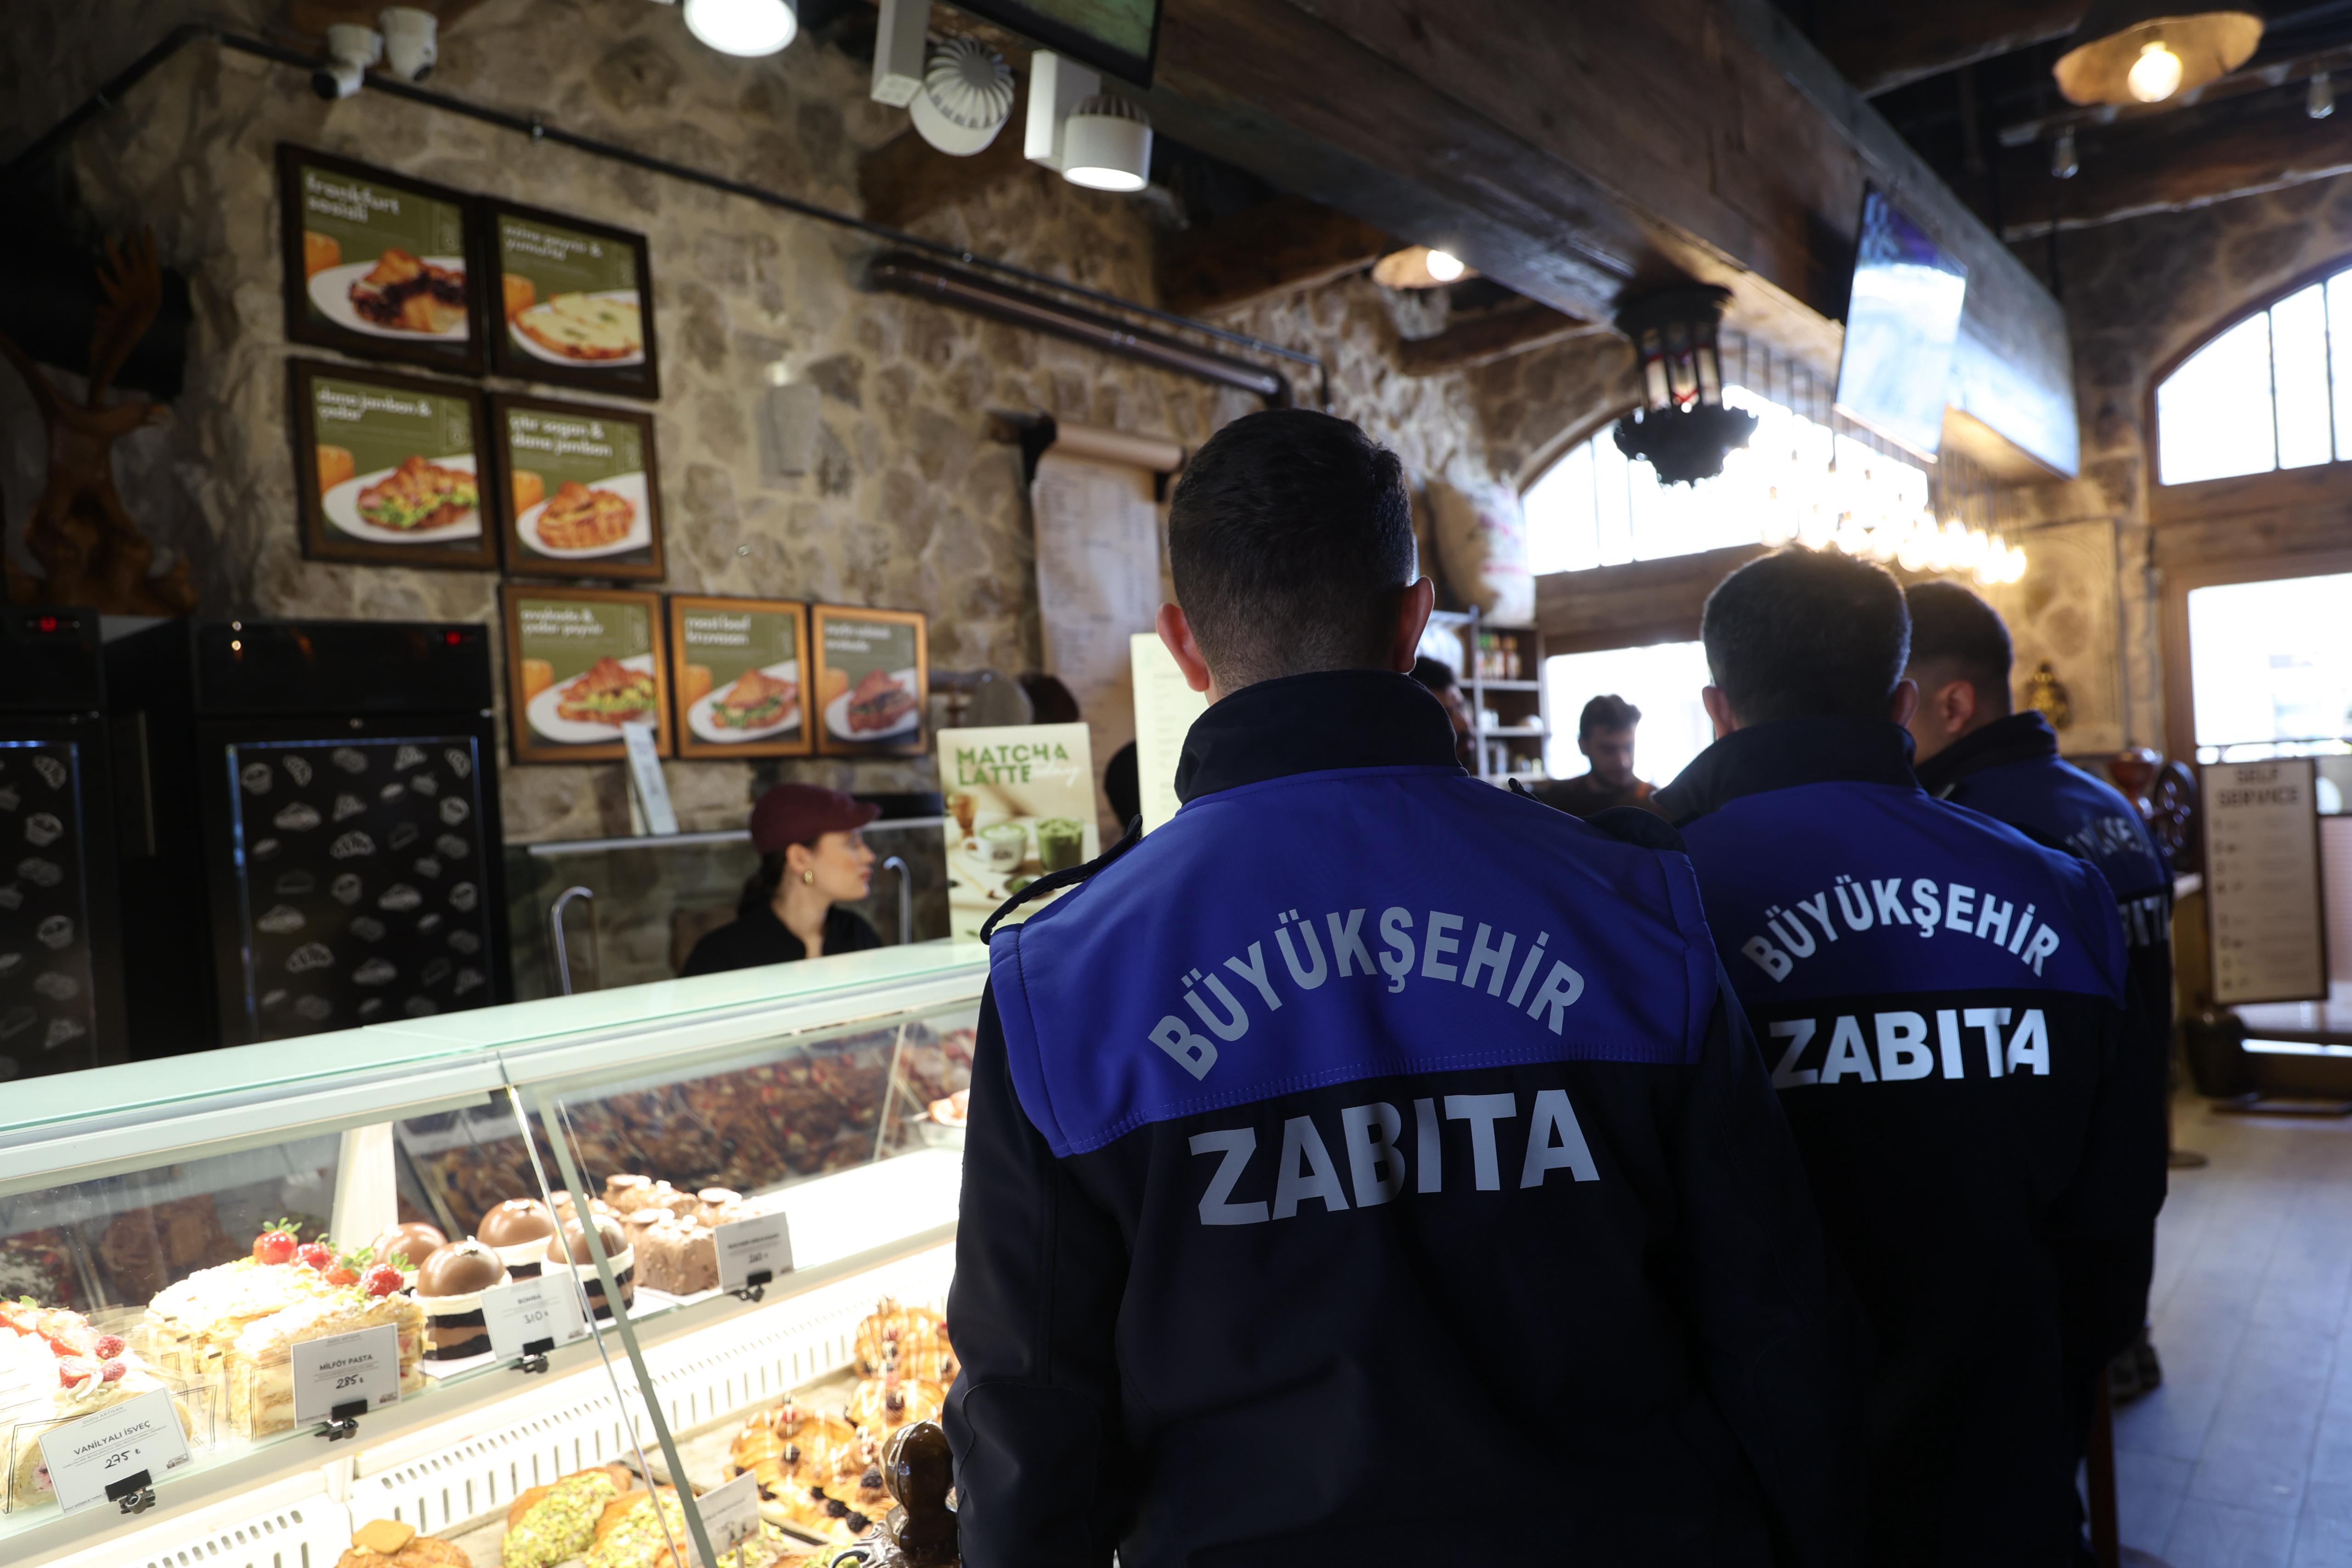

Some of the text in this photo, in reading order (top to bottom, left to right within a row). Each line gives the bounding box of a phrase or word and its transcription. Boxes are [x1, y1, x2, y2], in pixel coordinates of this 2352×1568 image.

[307, 172, 400, 216] frankfurt
[418, 399, 431, 417] &
[590, 421, 605, 440] &
[956, 742, 1069, 765] MATCHA
[957, 764, 1031, 786] LATTE
[2217, 786, 2297, 807] SERVICE
[1741, 874, 2059, 983] BÜYÜKŞEHİR
[1148, 906, 1585, 1082] BÜYÜKŞEHİR
[1769, 1007, 2050, 1090] ZABITA
[1188, 1089, 1600, 1226] ZABITA
[517, 1294, 542, 1305] BOMBA
[320, 1354, 373, 1371] MİLFÖY PASTA
[336, 1374, 359, 1389] 285
[82, 1406, 124, 1425] DUDU ARTISAN
[74, 1421, 151, 1455] VANİLYALI İSVEÇ
[105, 1450, 130, 1469] 275
